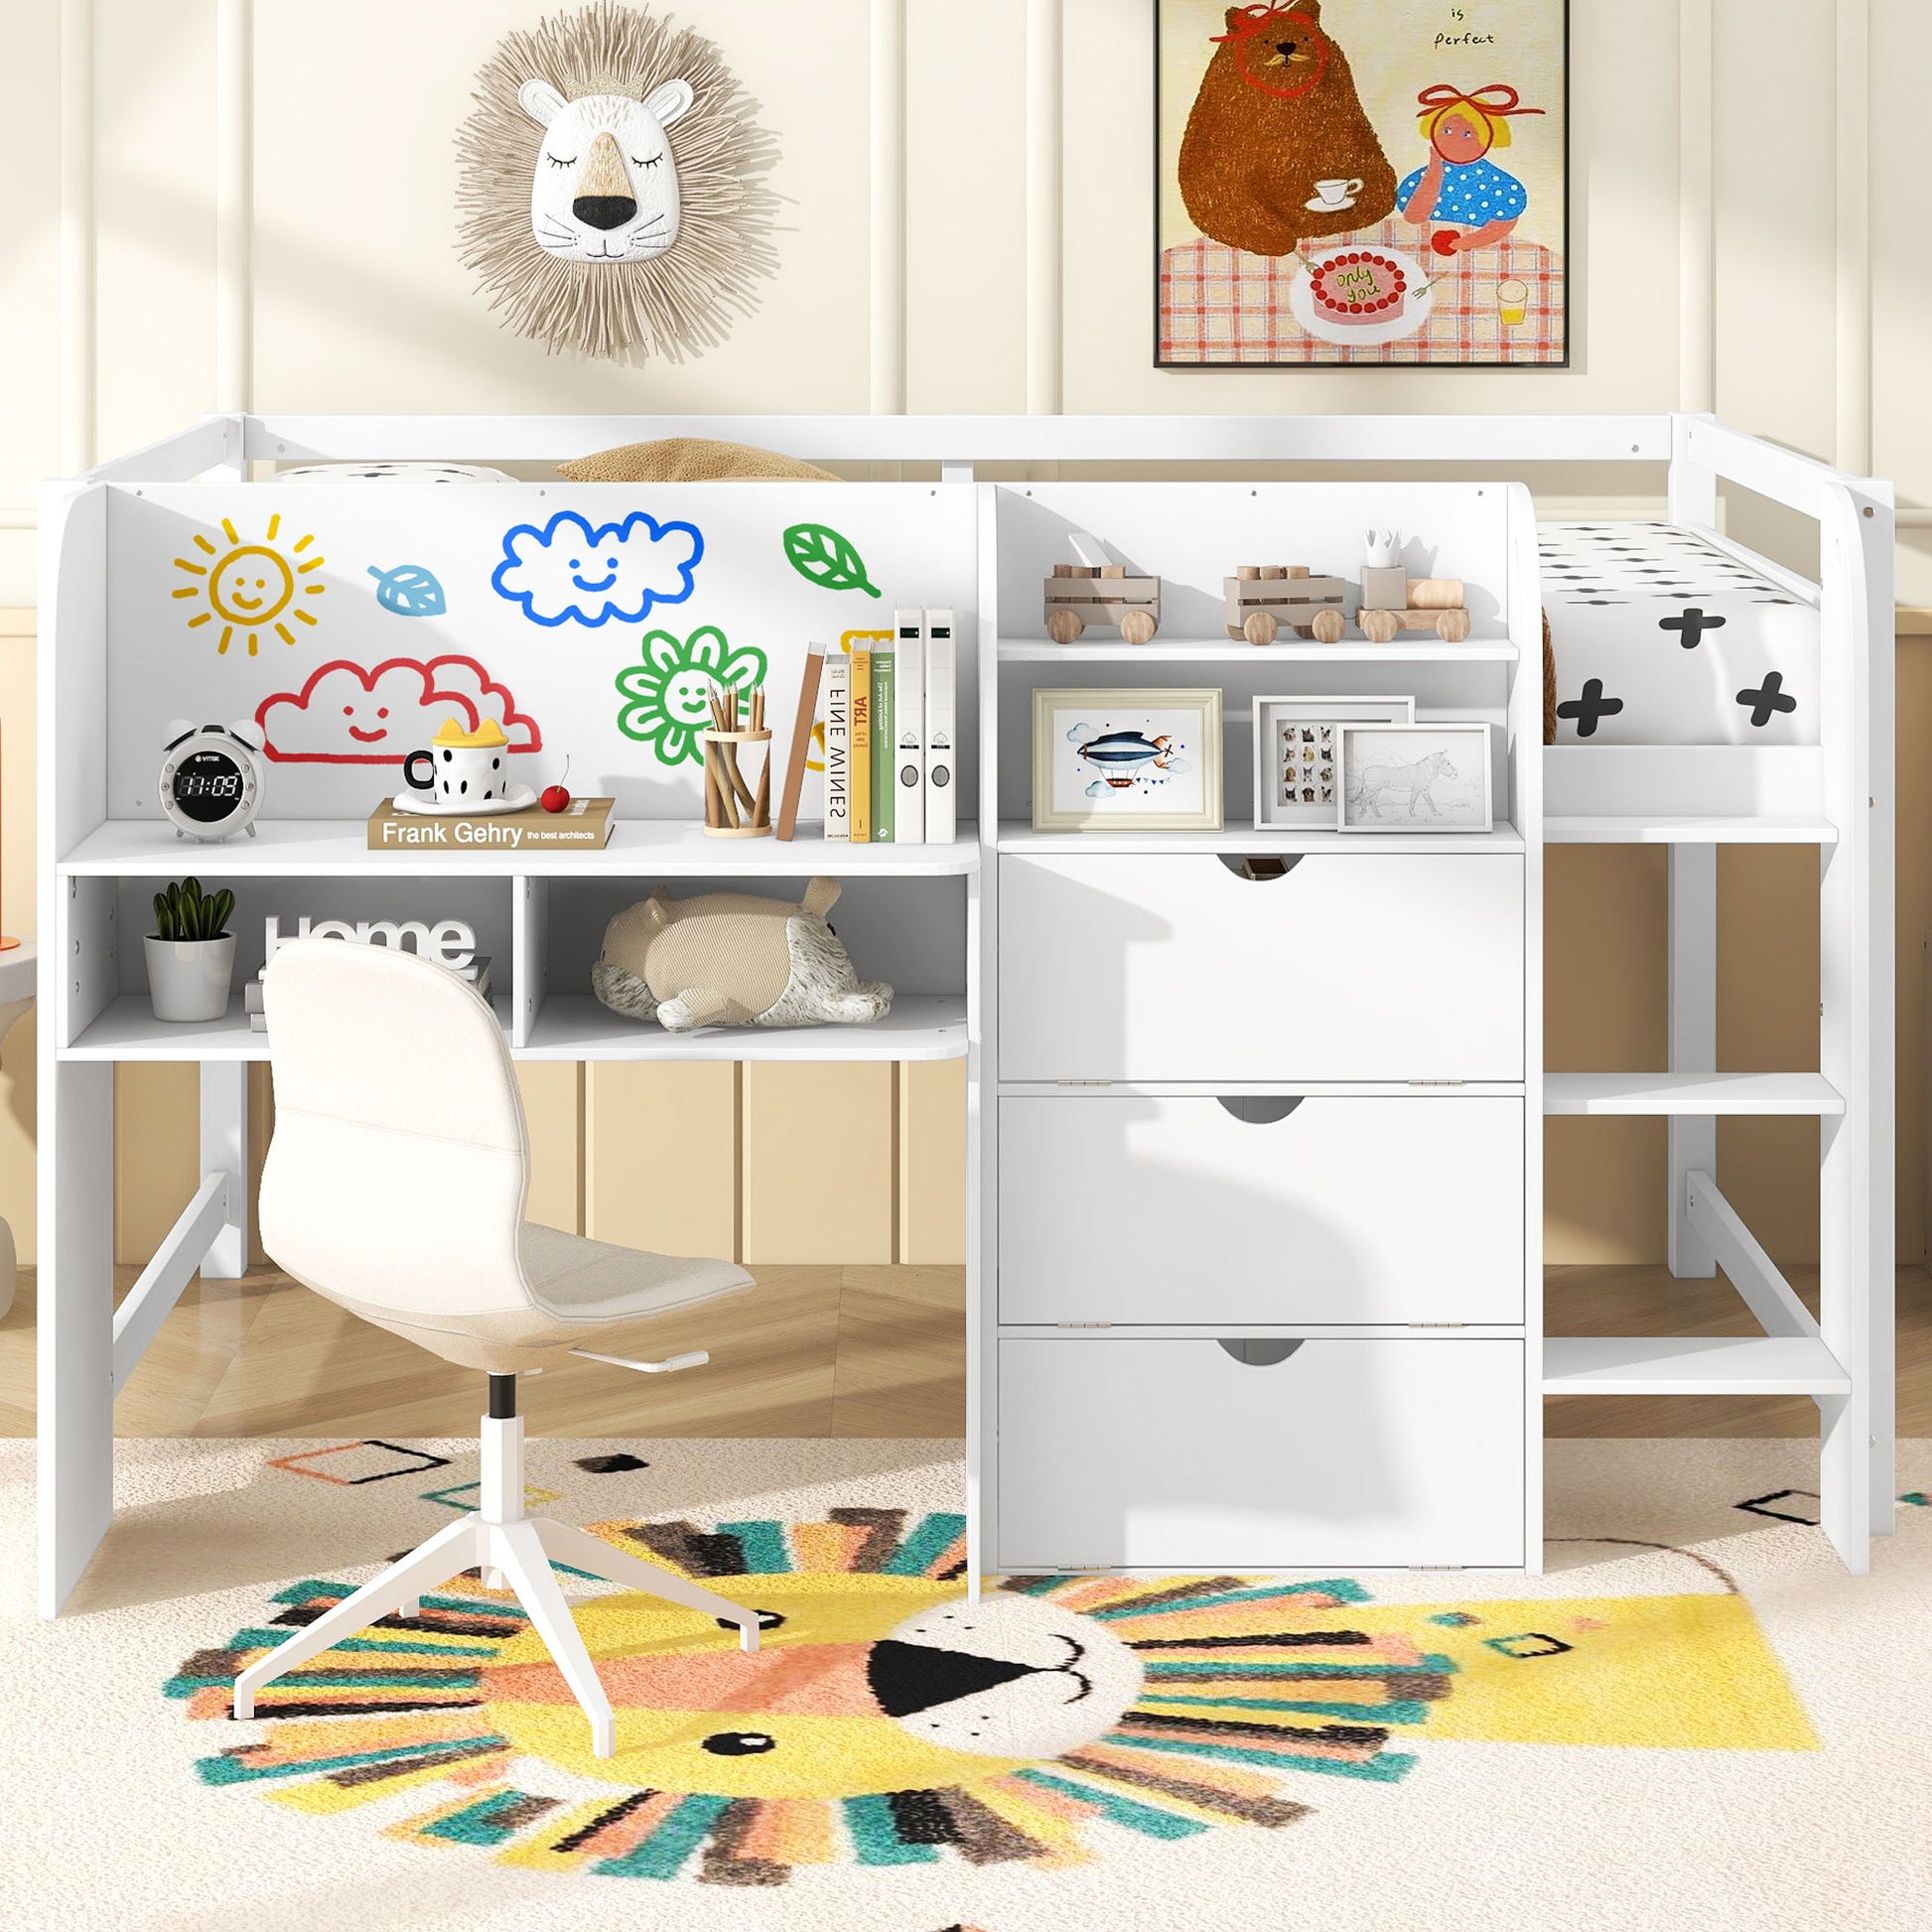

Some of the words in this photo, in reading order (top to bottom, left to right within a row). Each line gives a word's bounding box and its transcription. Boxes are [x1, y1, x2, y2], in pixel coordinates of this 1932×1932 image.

[1450, 8, 1464, 21] is
[1336, 265, 1374, 287] only
[1346, 285, 1381, 303] you
[187, 775, 238, 796] 11:09
[381, 821, 448, 844] Frank
[454, 821, 523, 848] Gehry
[527, 831, 540, 840] the
[540, 831, 558, 840] best
[558, 831, 595, 840] architects
